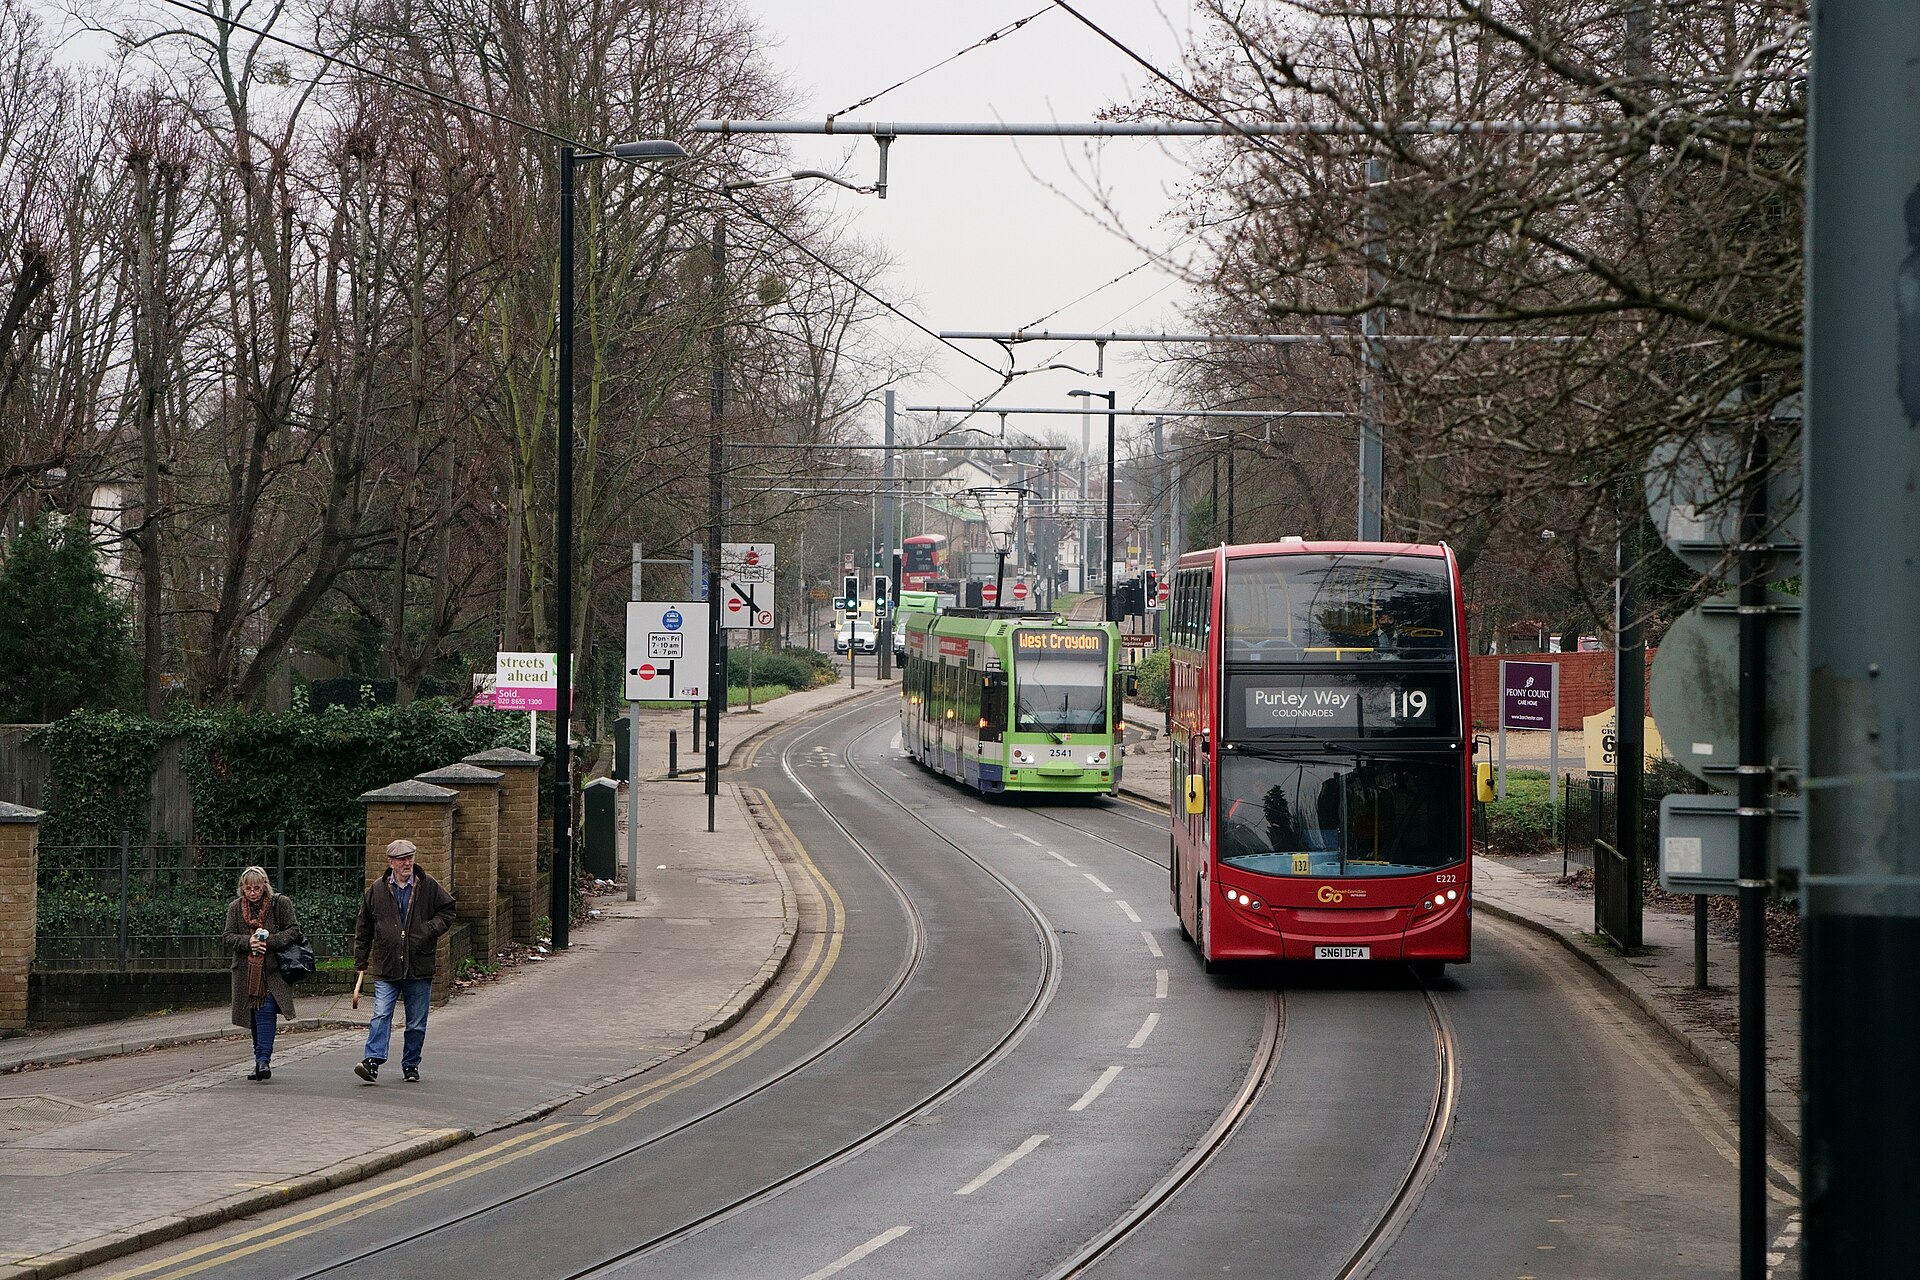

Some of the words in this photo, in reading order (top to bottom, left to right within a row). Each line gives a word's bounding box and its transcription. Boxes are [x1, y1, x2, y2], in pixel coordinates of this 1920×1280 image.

[1019, 633, 1047, 649] West
[1050, 634, 1099, 650] Croydon
[500, 657, 544, 668] streets
[507, 670, 548, 682] ahead
[1506, 688, 1526, 696] PEONY
[1527, 689, 1550, 698] COURT
[1255, 690, 1308, 709] Purley
[1313, 690, 1350, 709] Way
[1390, 690, 1428, 718] 119
[1272, 709, 1334, 717] COLONNADES
[1049, 749, 1072, 757] 2541
[1293, 860, 1308, 872] 132
[1436, 875, 1457, 883] E222
[1317, 885, 1343, 903] Go
[1320, 949, 1343, 958] SN61
[1344, 948, 1364, 958] DFA
